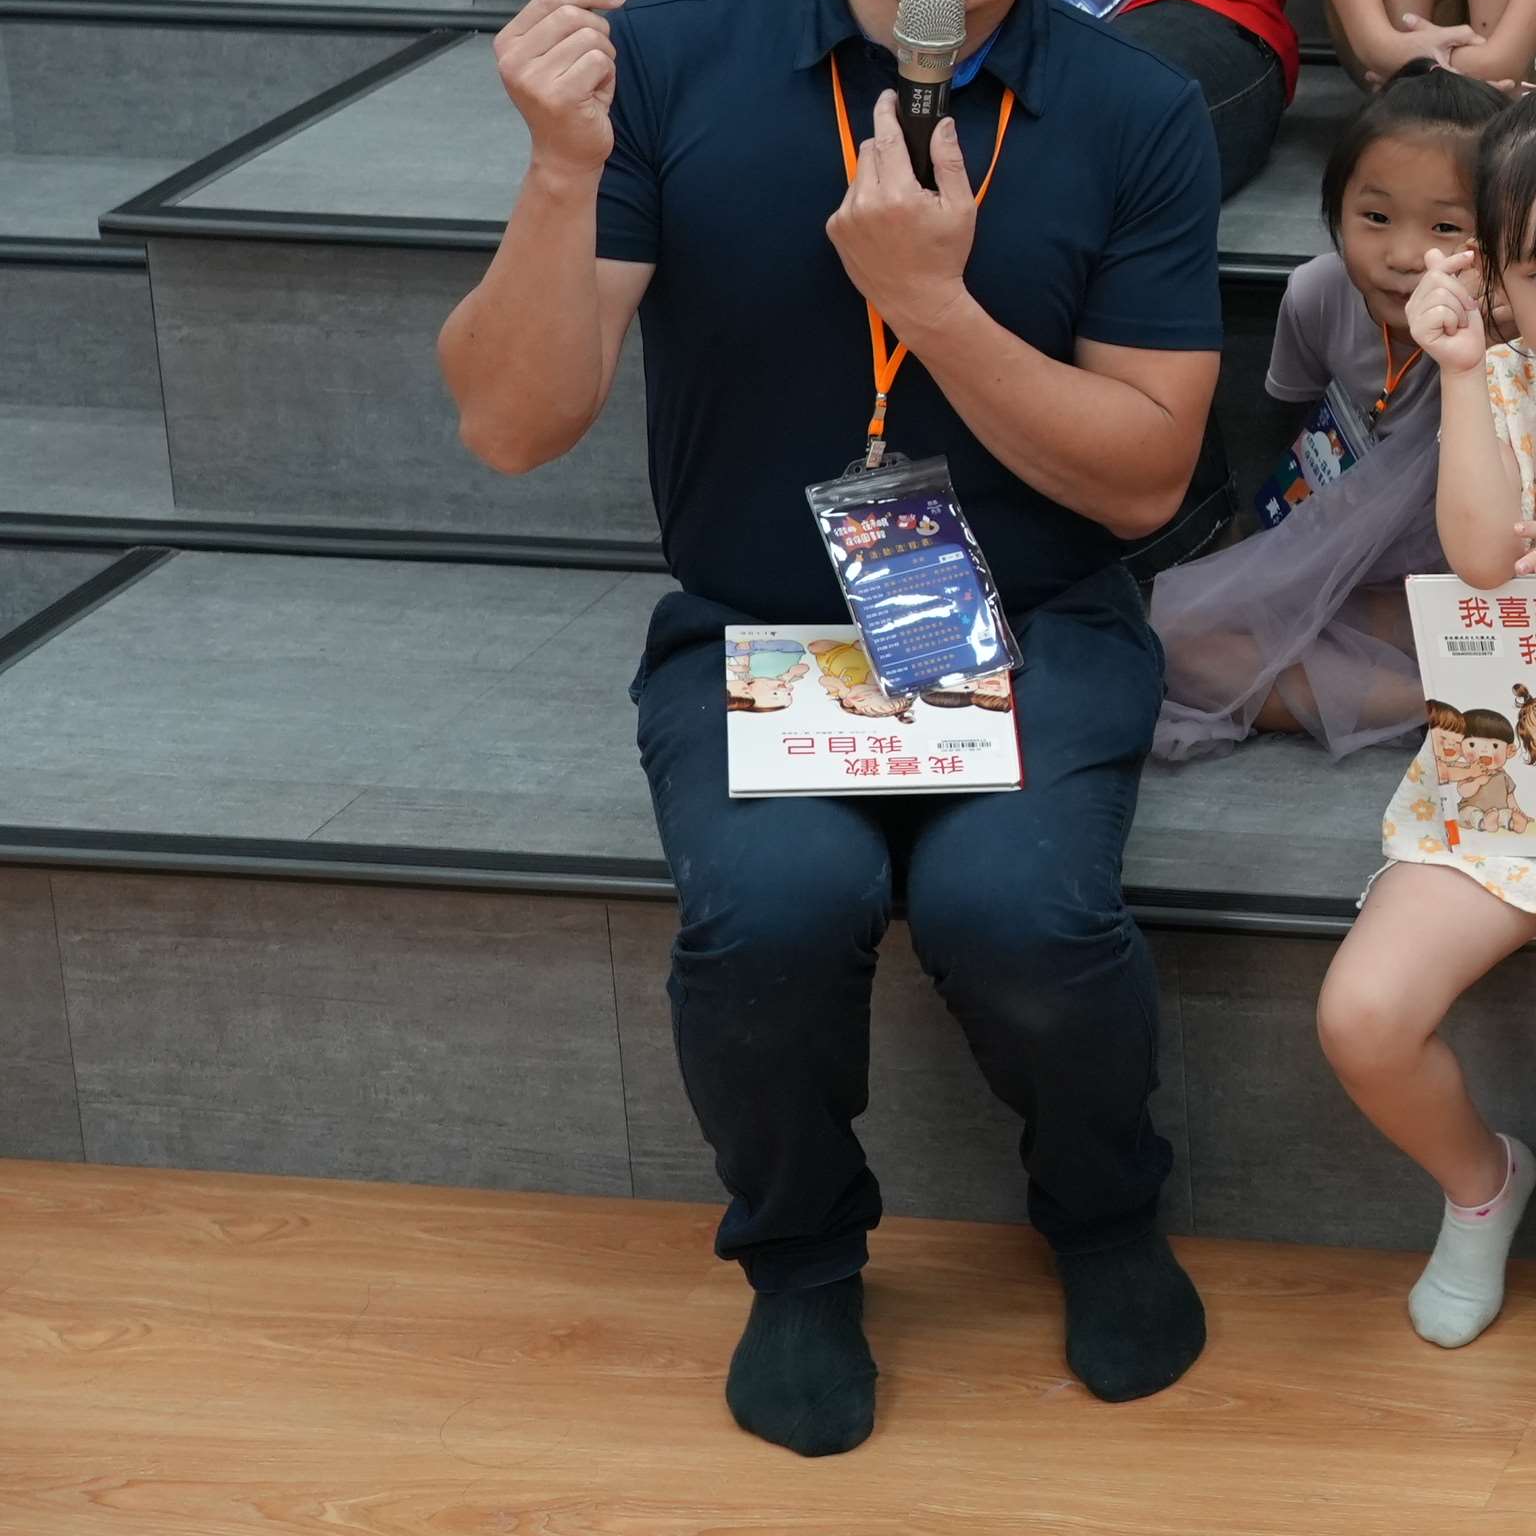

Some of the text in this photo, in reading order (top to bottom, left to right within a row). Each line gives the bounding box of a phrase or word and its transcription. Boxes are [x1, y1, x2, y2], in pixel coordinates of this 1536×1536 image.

[782, 735, 906, 756] 我自己
[846, 756, 965, 777] 我喜歡
